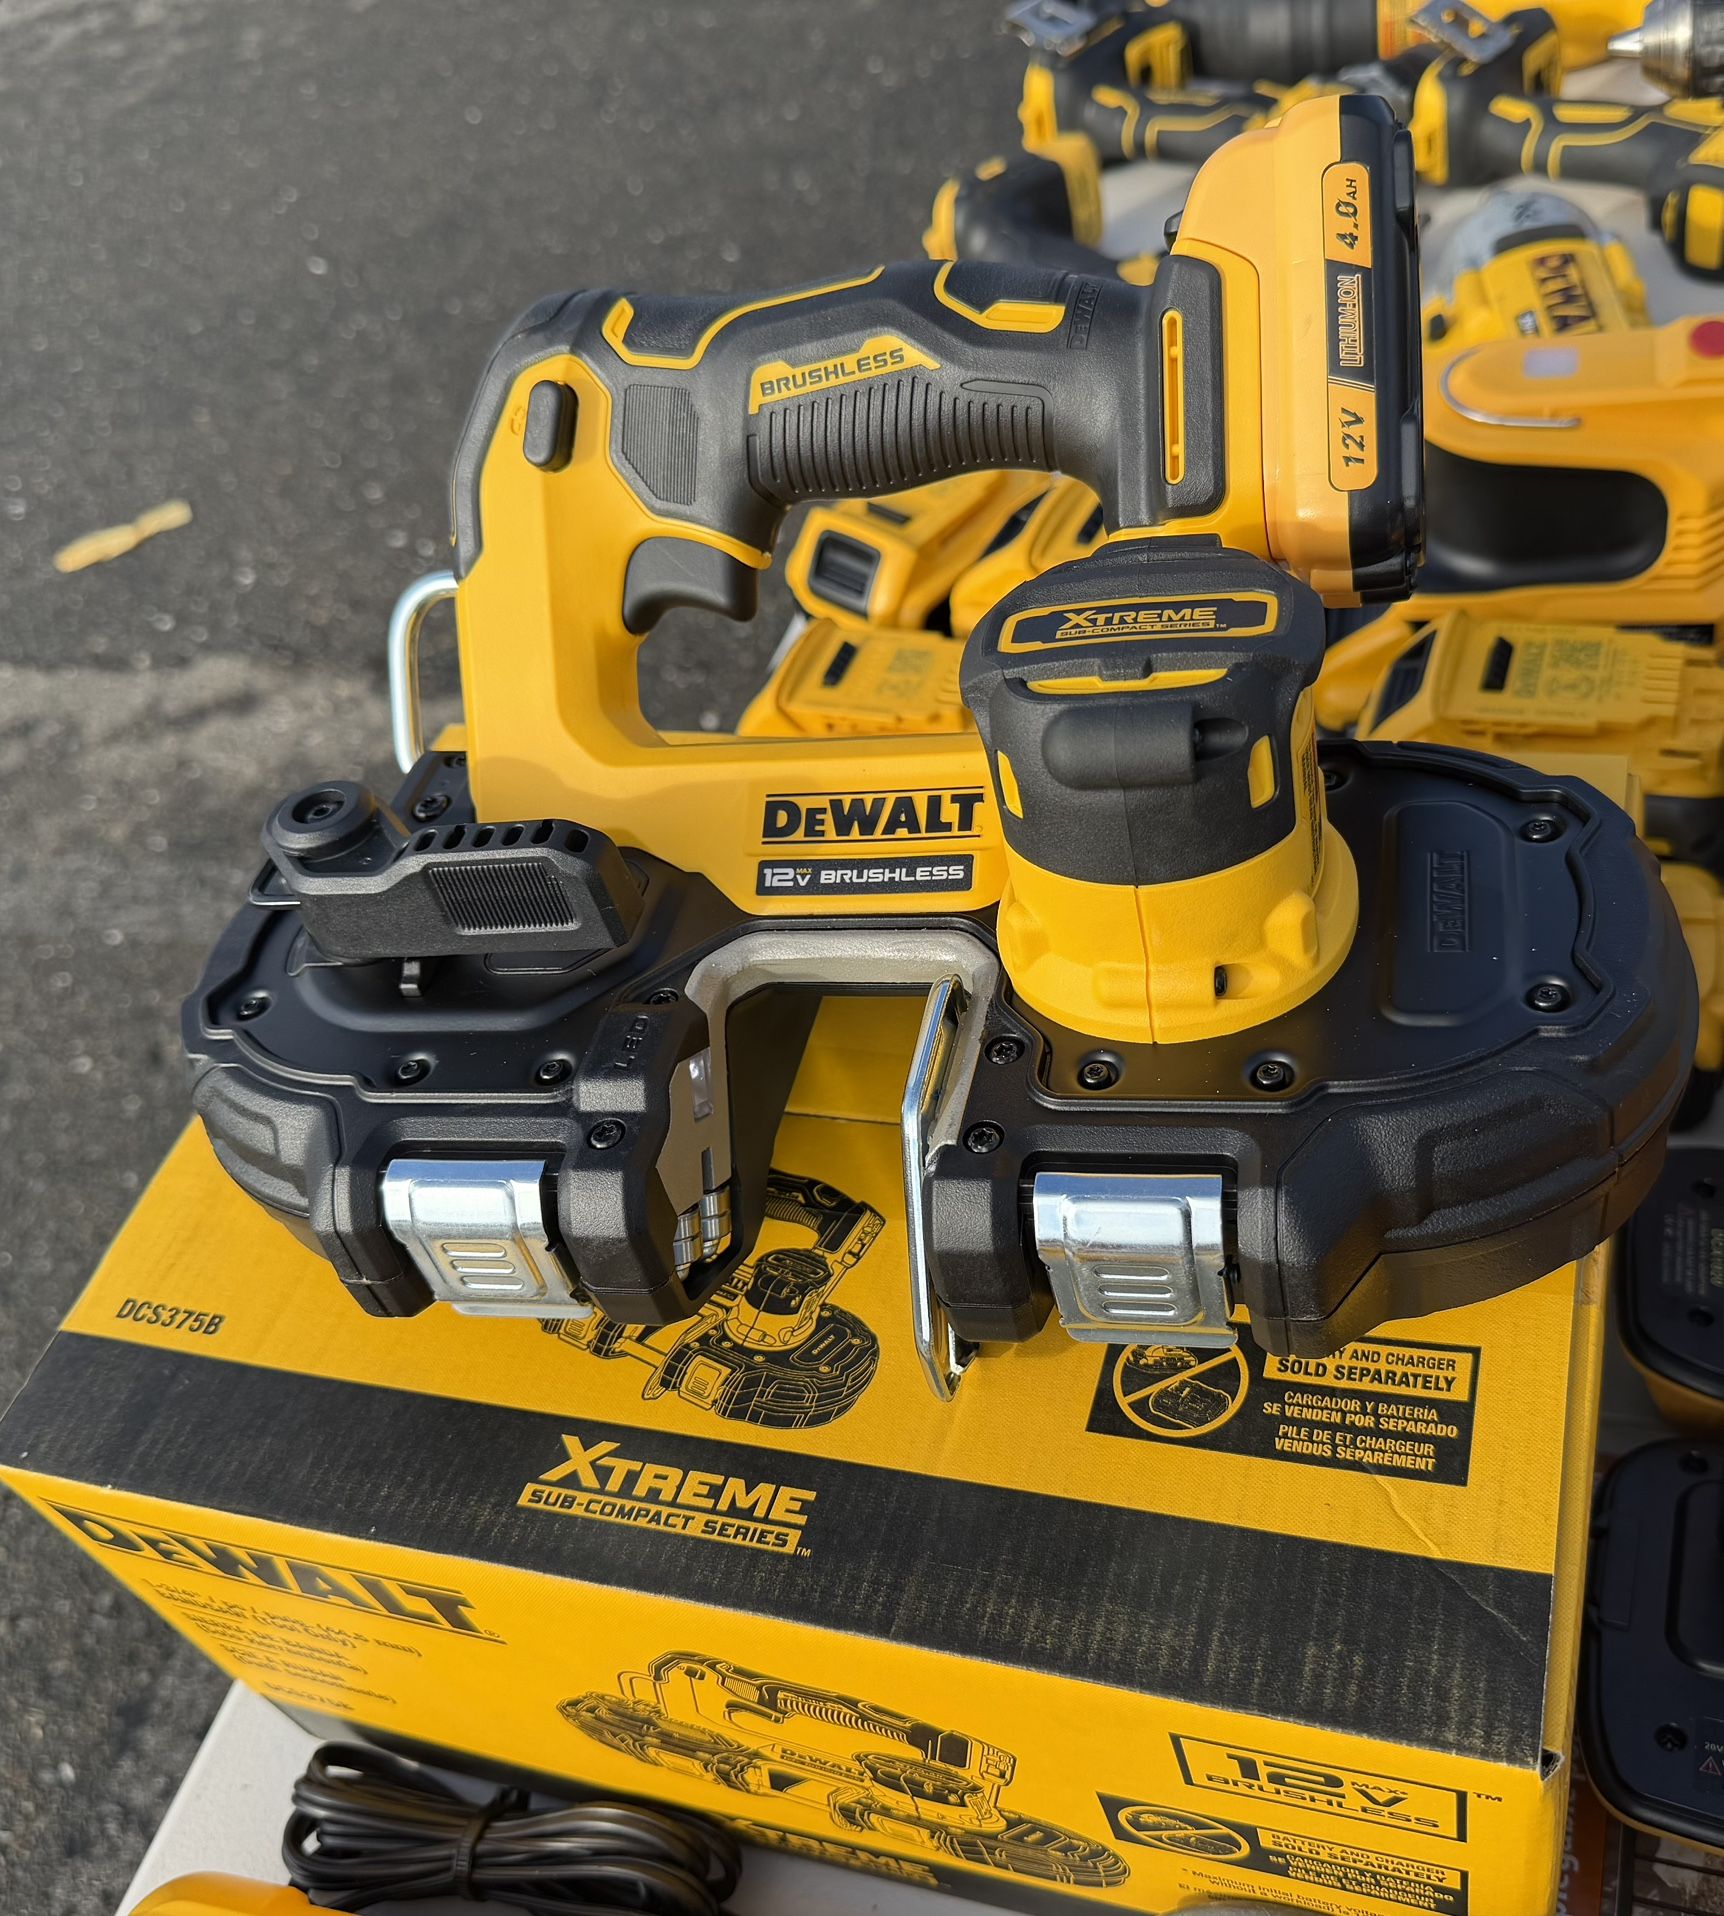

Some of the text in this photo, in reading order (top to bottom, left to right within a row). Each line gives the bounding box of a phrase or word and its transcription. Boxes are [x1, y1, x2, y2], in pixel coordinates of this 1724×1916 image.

[1337, 274, 1362, 367] LITHIUM-ION
[760, 347, 905, 397] BRUSHLESS
[1340, 406, 1366, 468] 12V
[1058, 607, 1218, 630] XTREME
[1059, 624, 1159, 638] SUB-COMPACT
[1161, 621, 1211, 630] SERIES
[762, 793, 984, 839] DEWALT
[819, 864, 965, 885] BRUSHLESS
[613, 1014, 649, 1070] LED
[115, 1297, 226, 1336] DCS375B
[1277, 1358, 1457, 1392] SOLD SEPARATELY
[1350, 1350, 1382, 1364] AND
[1385, 1352, 1457, 1372] CHARGER
[1263, 1401, 1459, 1438] SE VENDEN POR SEPARADO
[1284, 1391, 1361, 1413] CARGADOR
[1366, 1401, 1375, 1412] Y
[1274, 1438, 1332, 1458] VENDUS
[1278, 1424, 1435, 1457] PILE DE ET CHARGEUR
[538, 1433, 817, 1526] XTREME
[526, 1487, 697, 1531] SUB-COMPACT
[700, 1517, 790, 1549] SERIES
[46, 1502, 484, 1634] DEWALT
[1205, 1773, 1440, 1829] BRUSHLESS
[1271, 1833, 1446, 1876] BATTERY AND CHARGER
[1272, 1840, 1447, 1883] SOLD SEPARATELY
